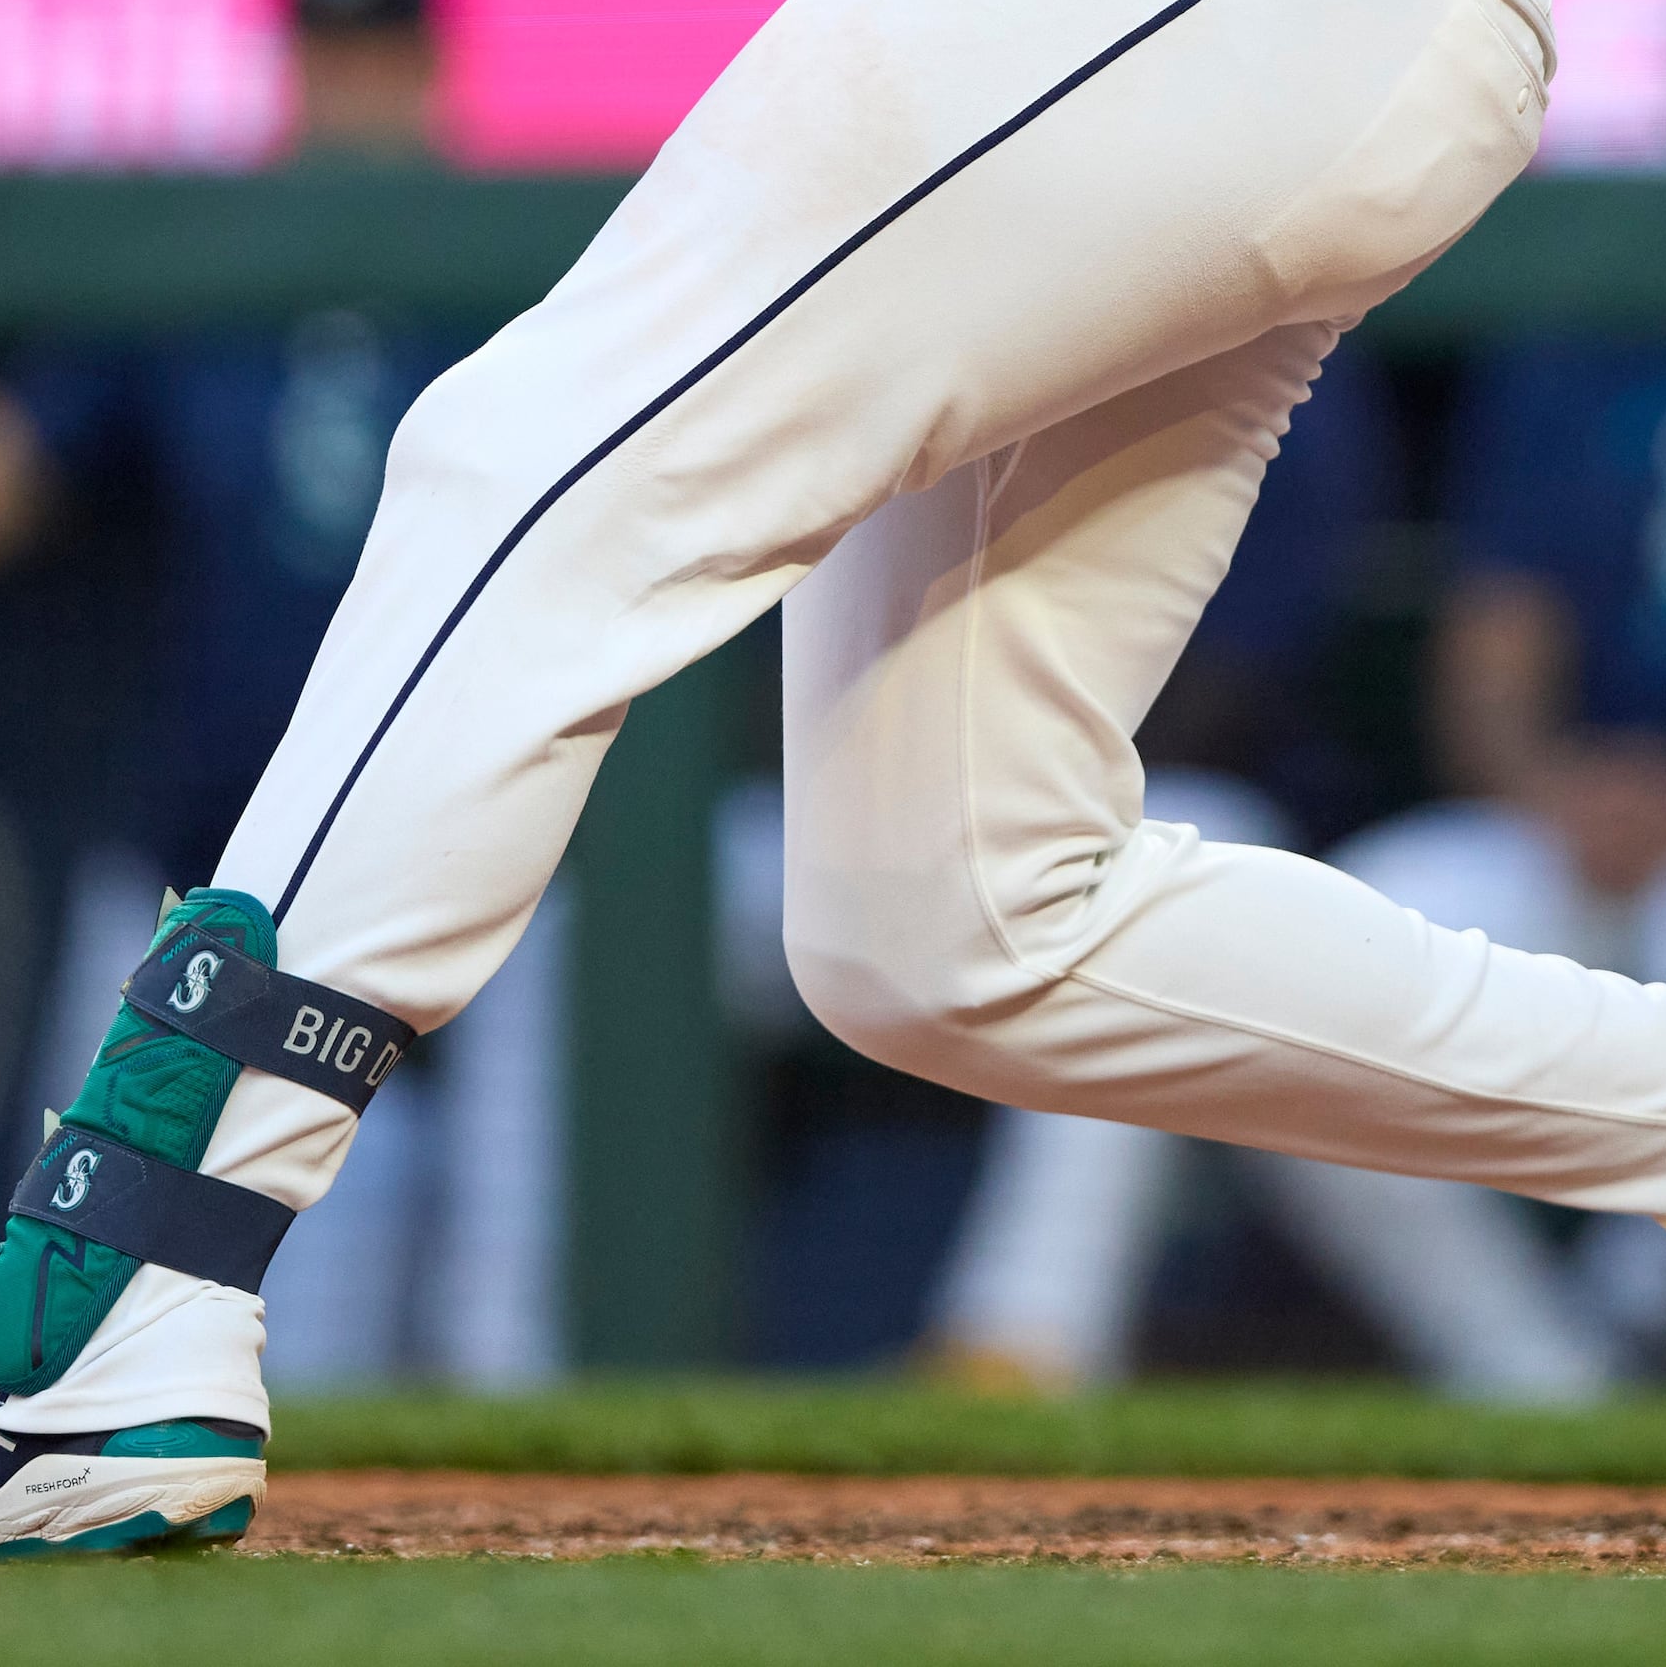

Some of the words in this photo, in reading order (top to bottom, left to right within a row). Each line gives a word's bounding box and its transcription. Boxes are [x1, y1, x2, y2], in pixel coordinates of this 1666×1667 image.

[282, 1004, 372, 1073] BIG
[364, 1040, 404, 1088] D
[25, 1482, 56, 1495] FRESH
